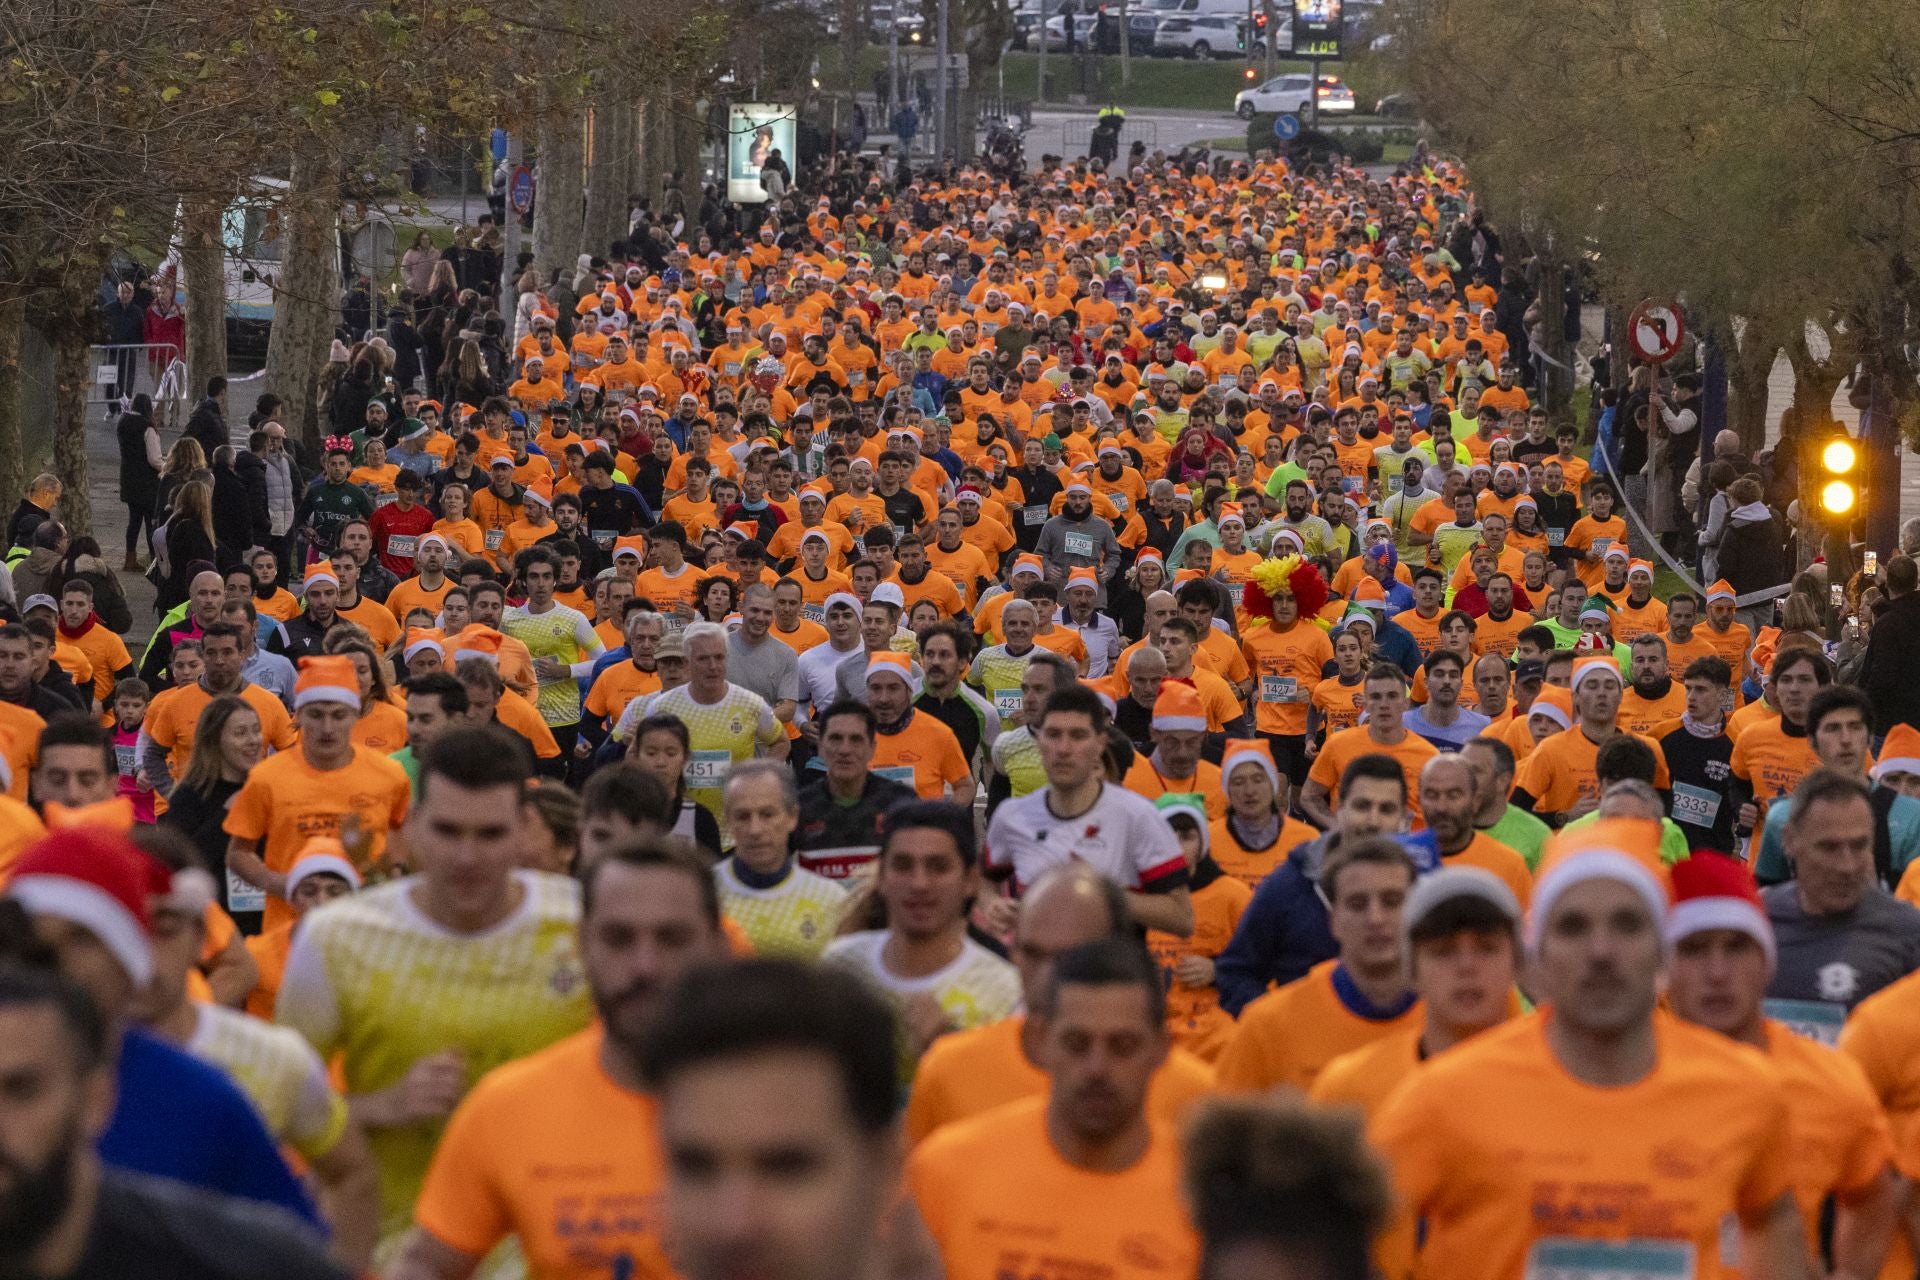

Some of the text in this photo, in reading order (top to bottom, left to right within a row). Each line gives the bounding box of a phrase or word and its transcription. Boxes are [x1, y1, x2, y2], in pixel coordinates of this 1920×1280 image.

[1067, 539, 1087, 549] 1740
[1264, 684, 1290, 695] 1427
[1000, 698, 1021, 709] 421
[685, 762, 714, 776] 451
[1674, 793, 1709, 814] 2333
